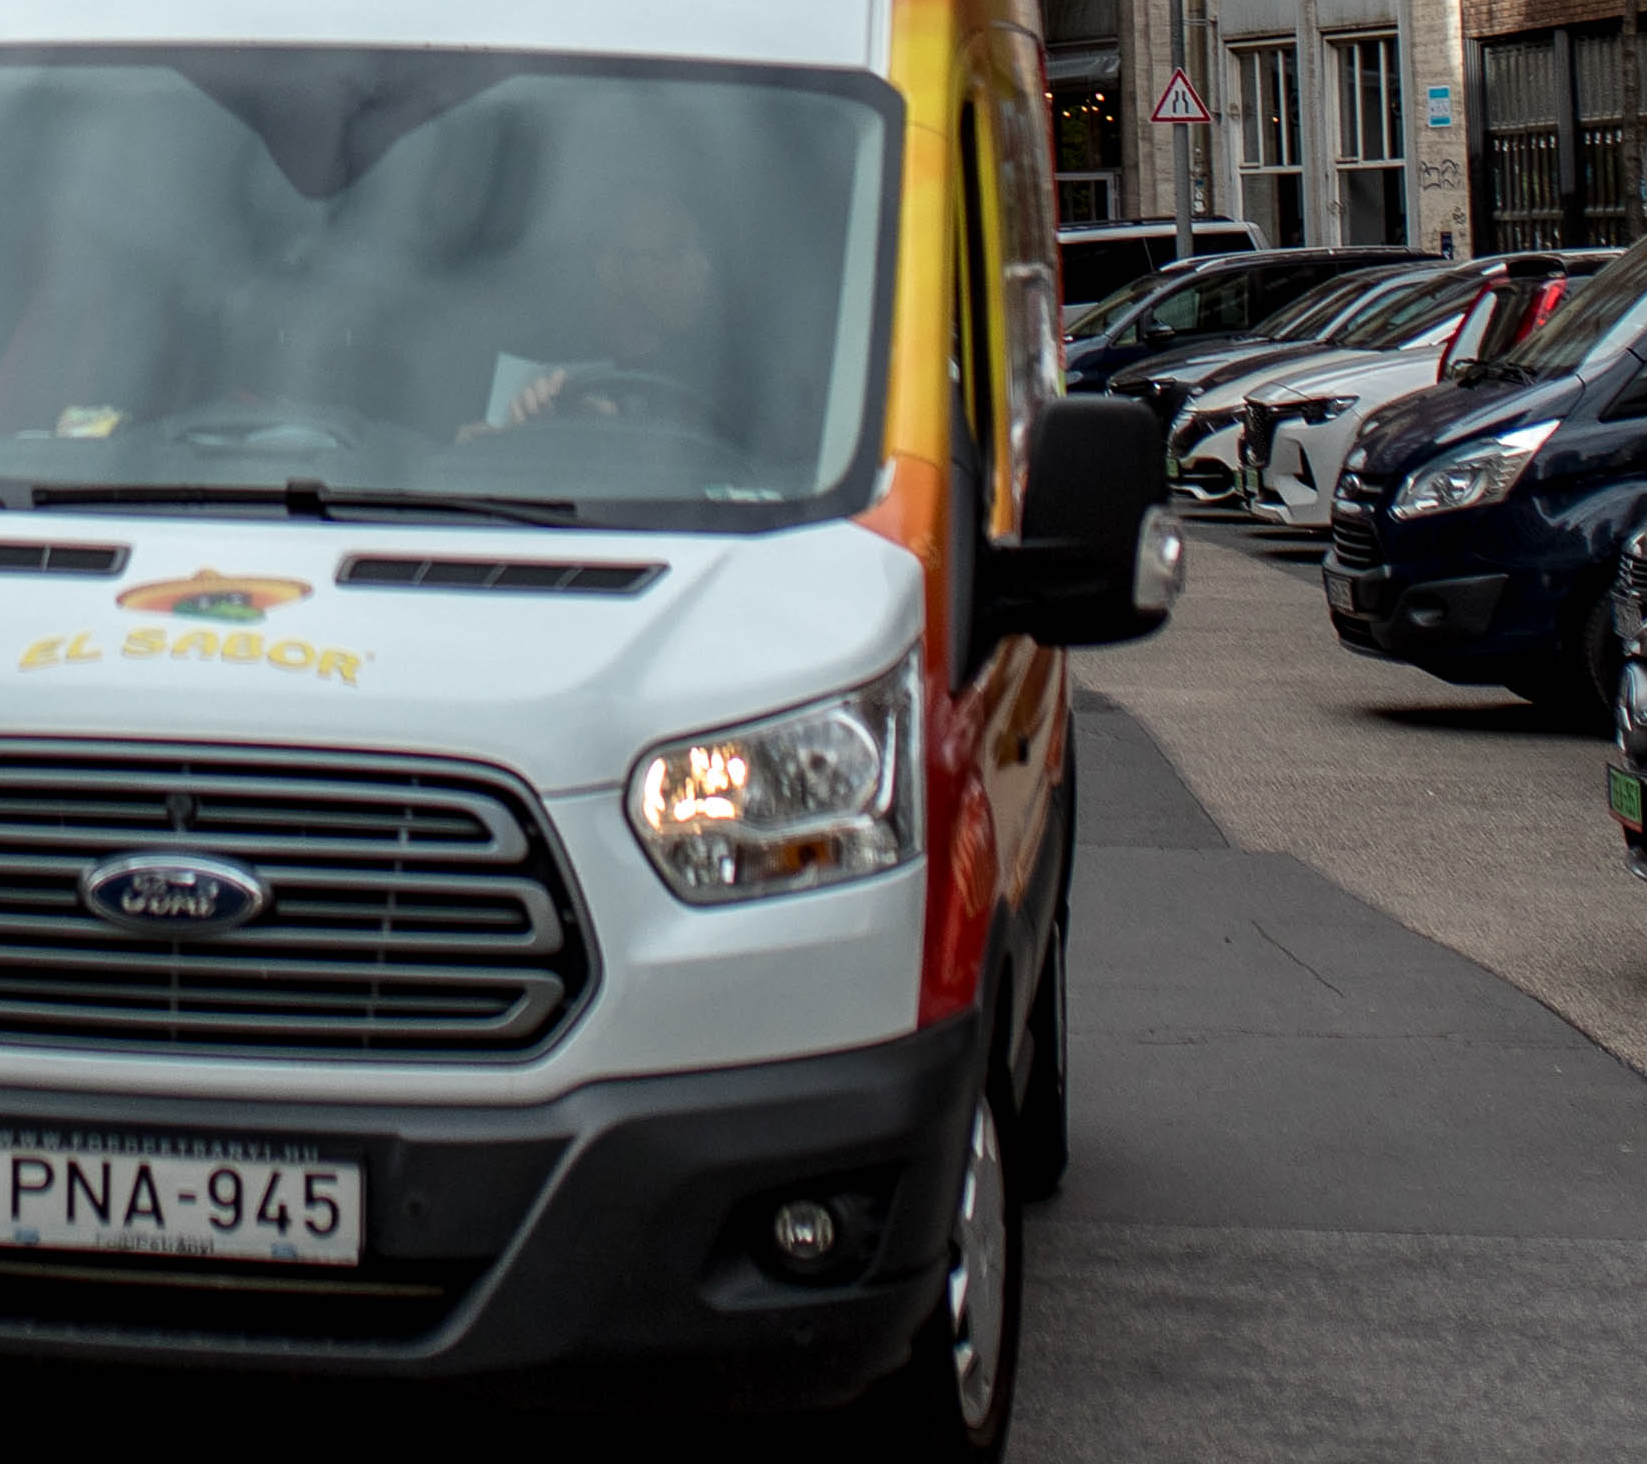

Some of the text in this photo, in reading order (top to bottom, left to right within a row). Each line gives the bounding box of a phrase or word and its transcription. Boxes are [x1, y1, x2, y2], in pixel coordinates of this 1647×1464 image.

[19, 625, 367, 685] EL SABOR
[11, 1156, 342, 1239] PNA-945
